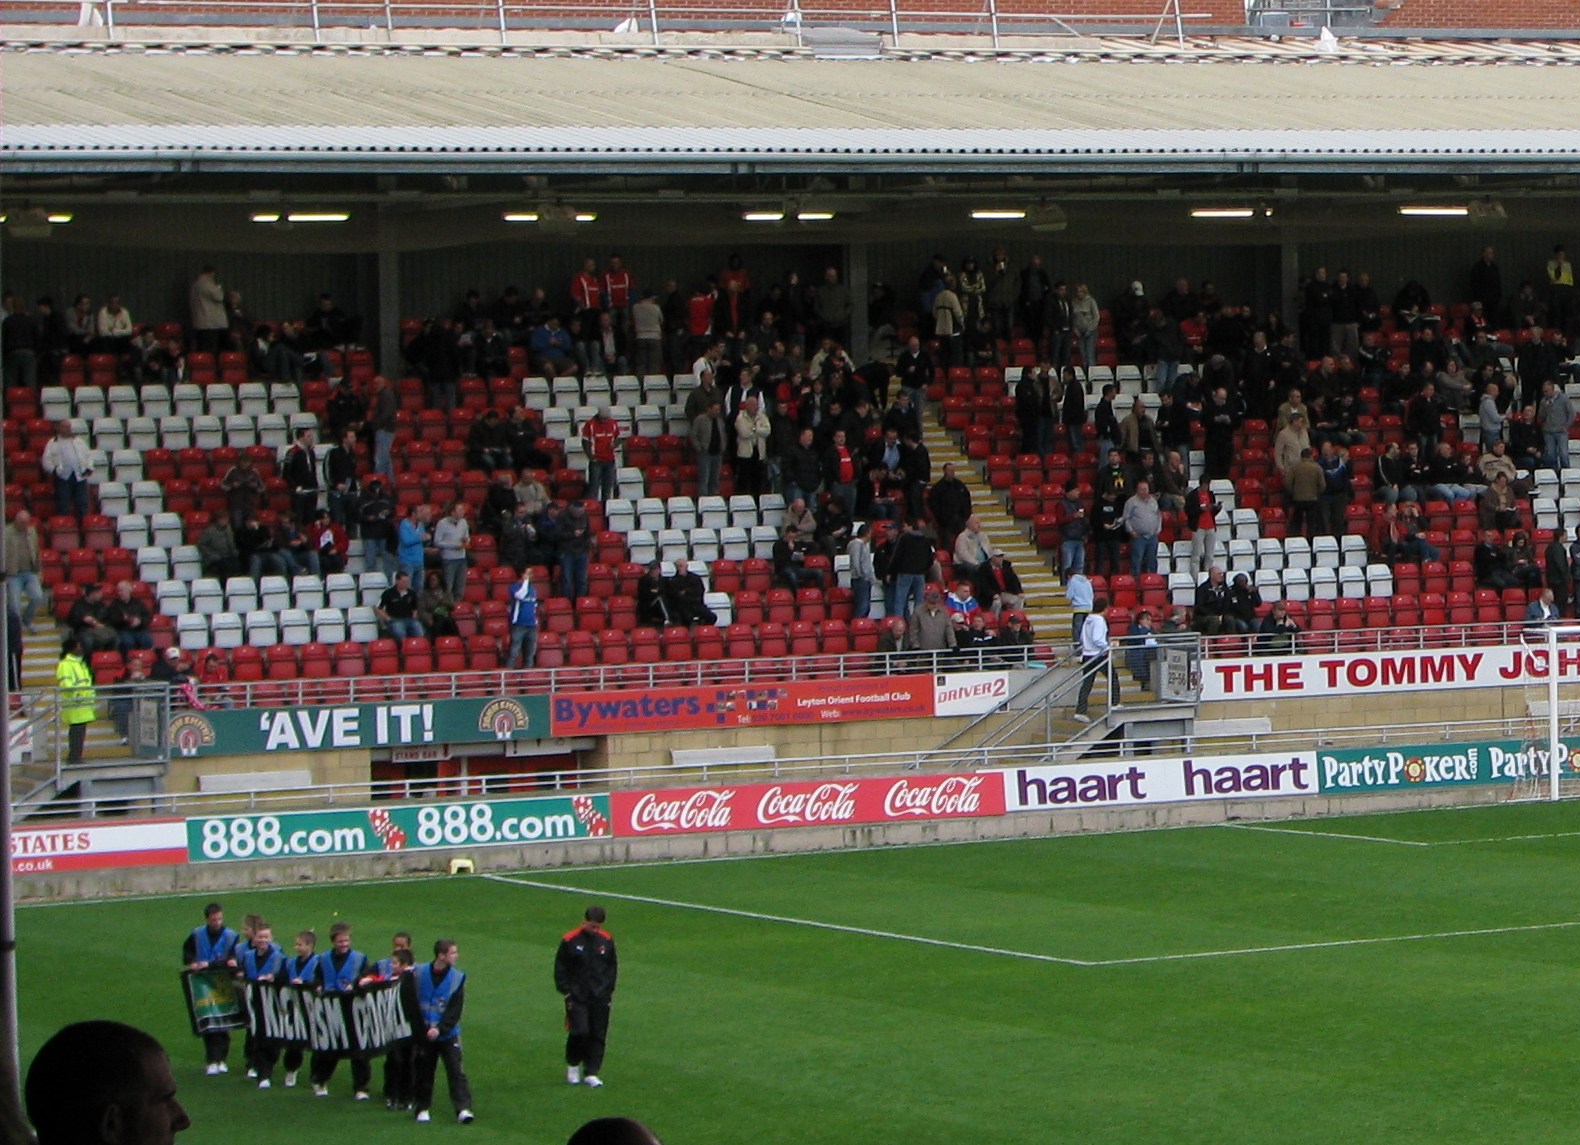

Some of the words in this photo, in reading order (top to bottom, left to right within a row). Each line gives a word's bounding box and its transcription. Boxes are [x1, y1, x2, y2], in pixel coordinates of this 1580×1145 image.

[1215, 663, 1304, 693] THE
[1319, 653, 1484, 689] TOMMY
[555, 695, 700, 727] Bywaters
[797, 697, 826, 707] Leyton
[827, 695, 854, 704] Orient
[856, 692, 889, 703] Football
[891, 692, 911, 701] Club
[376, 703, 434, 745] IT!
[883, 776, 985, 816] Coca-Cola
[1017, 766, 1147, 805] haart
[1184, 757, 1309, 796] haart
[630, 788, 735, 832] Coca-Cola
[756, 782, 860, 823] Coca-Cola
[202, 816, 365, 858] 888.com
[417, 804, 575, 844] 888.com
